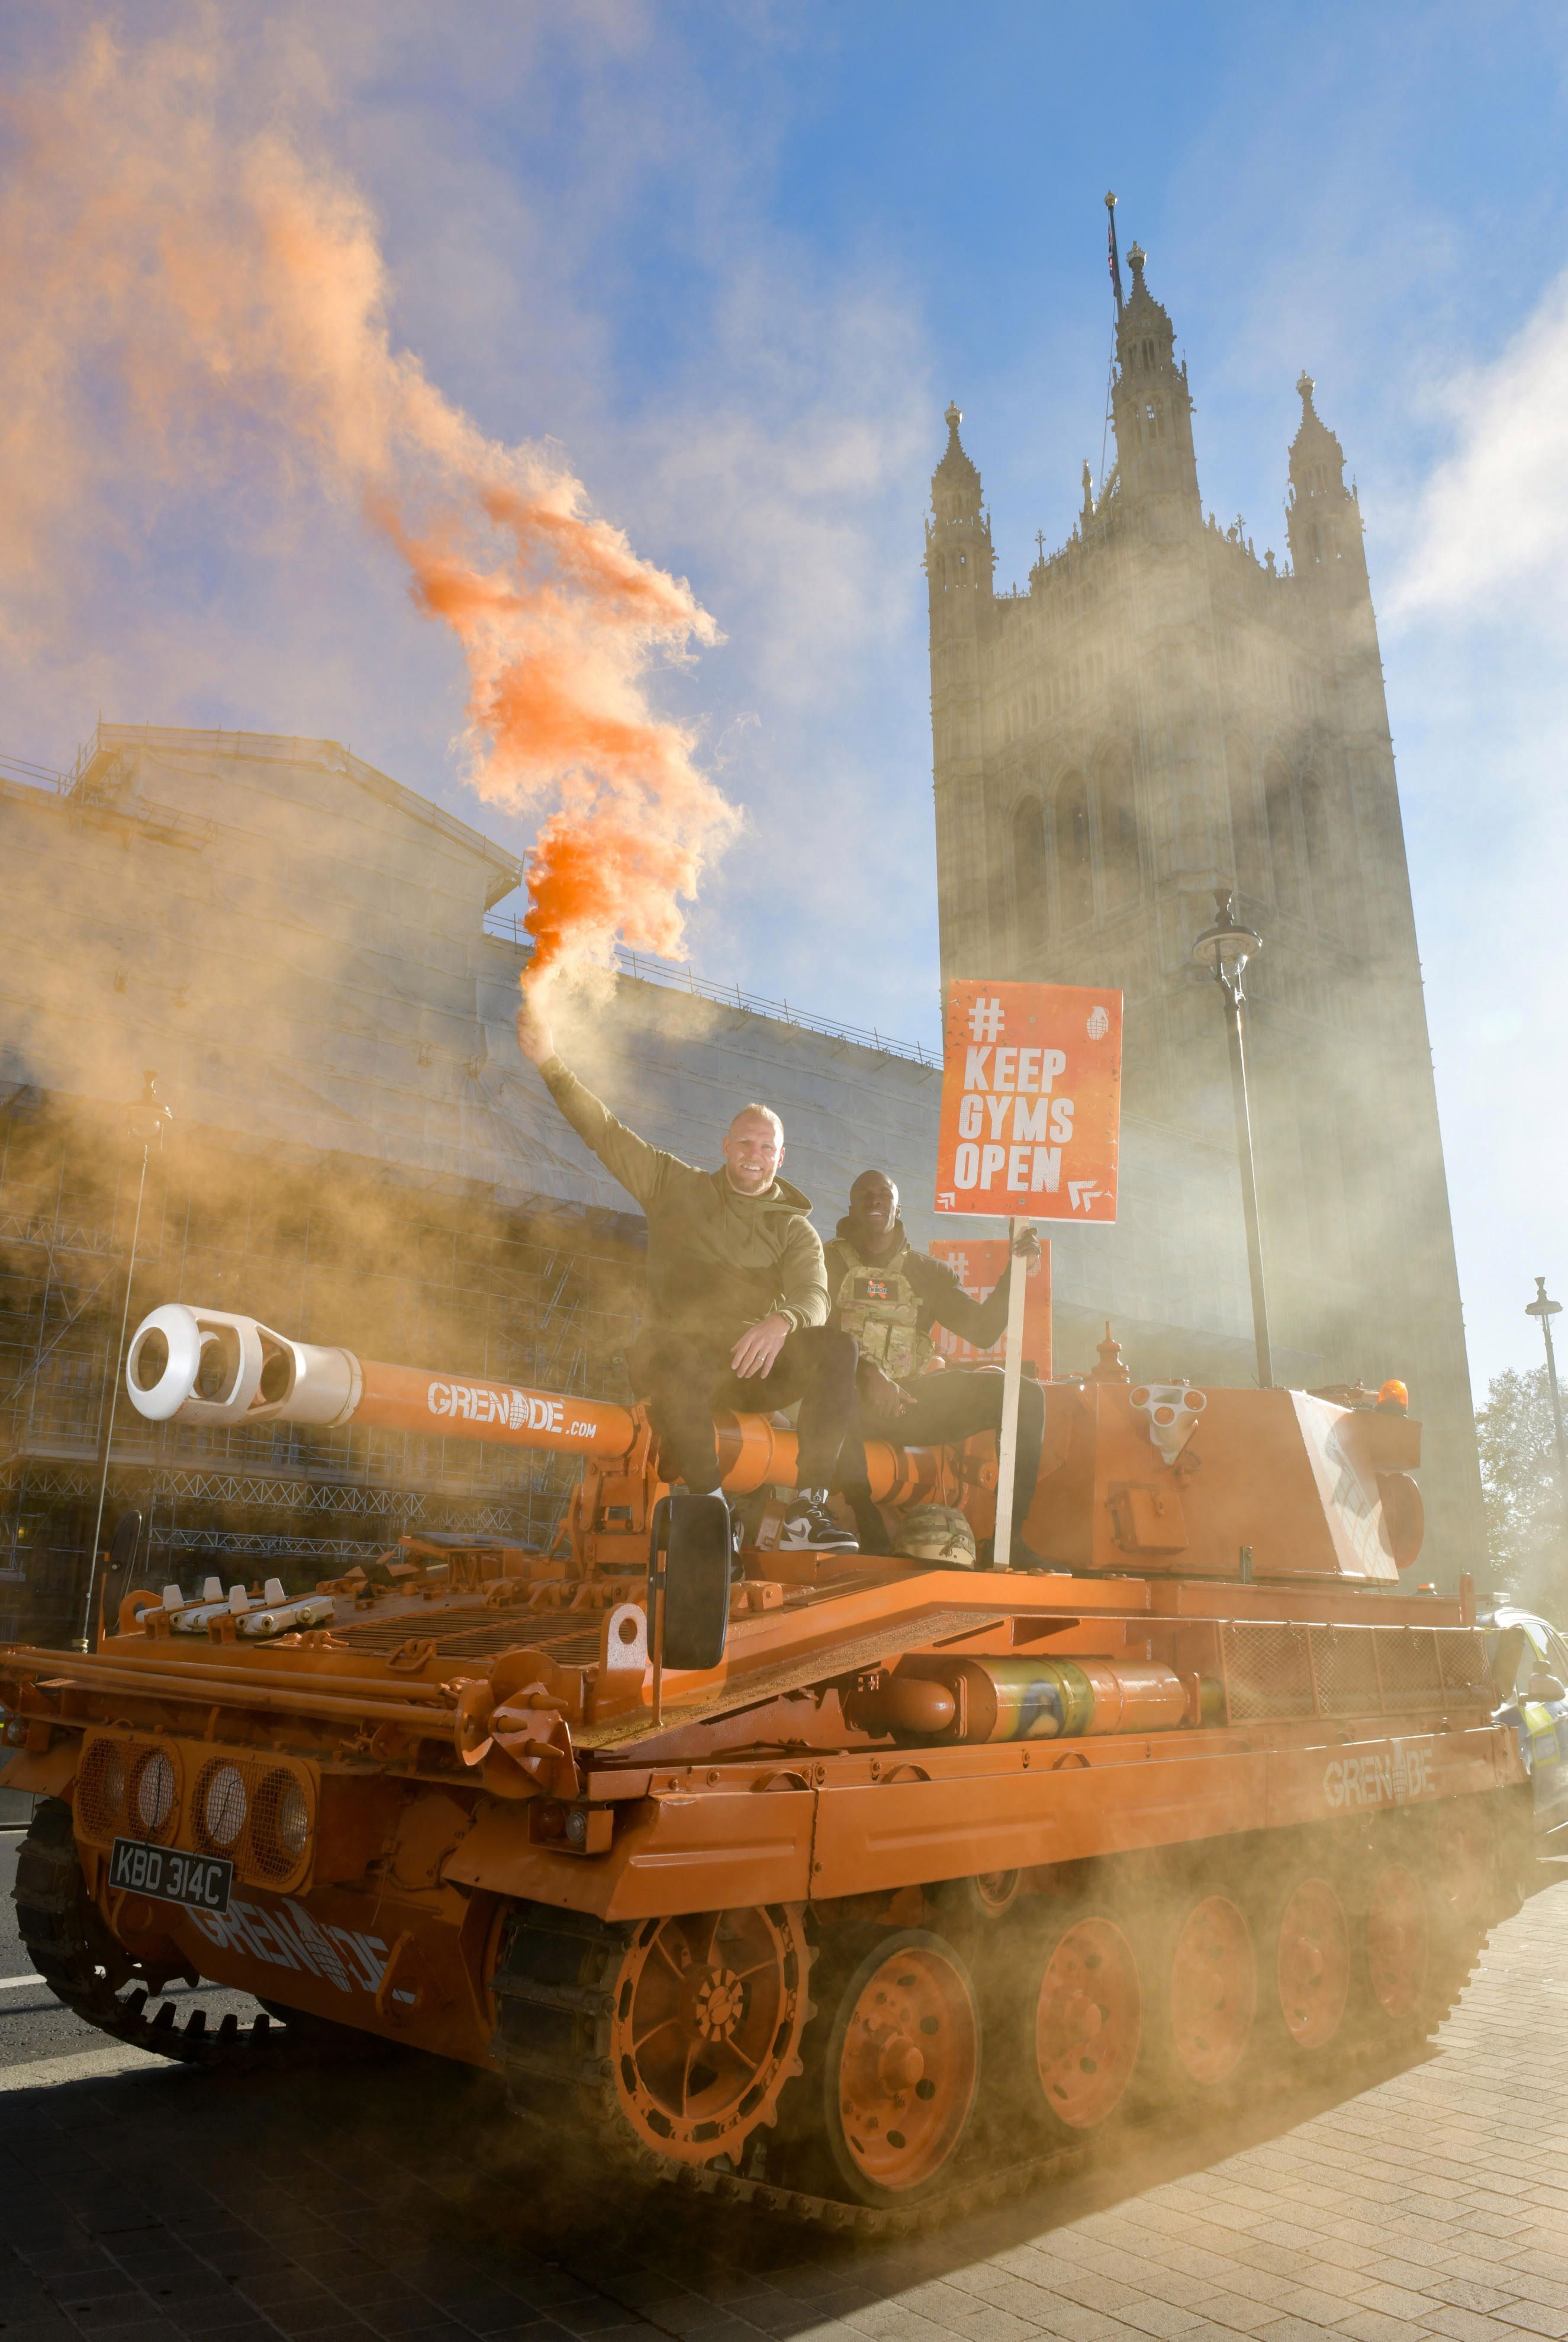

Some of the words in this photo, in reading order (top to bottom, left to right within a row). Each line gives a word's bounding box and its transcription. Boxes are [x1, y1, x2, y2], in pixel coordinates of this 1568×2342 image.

[968, 997, 1005, 1042] #
[963, 1045, 1066, 1093] KEEP
[958, 1094, 1075, 1143] GYMS
[954, 1142, 1062, 1193] OPEN
[116, 1845, 163, 1890] KBD
[166, 1857, 223, 1905] 314C
